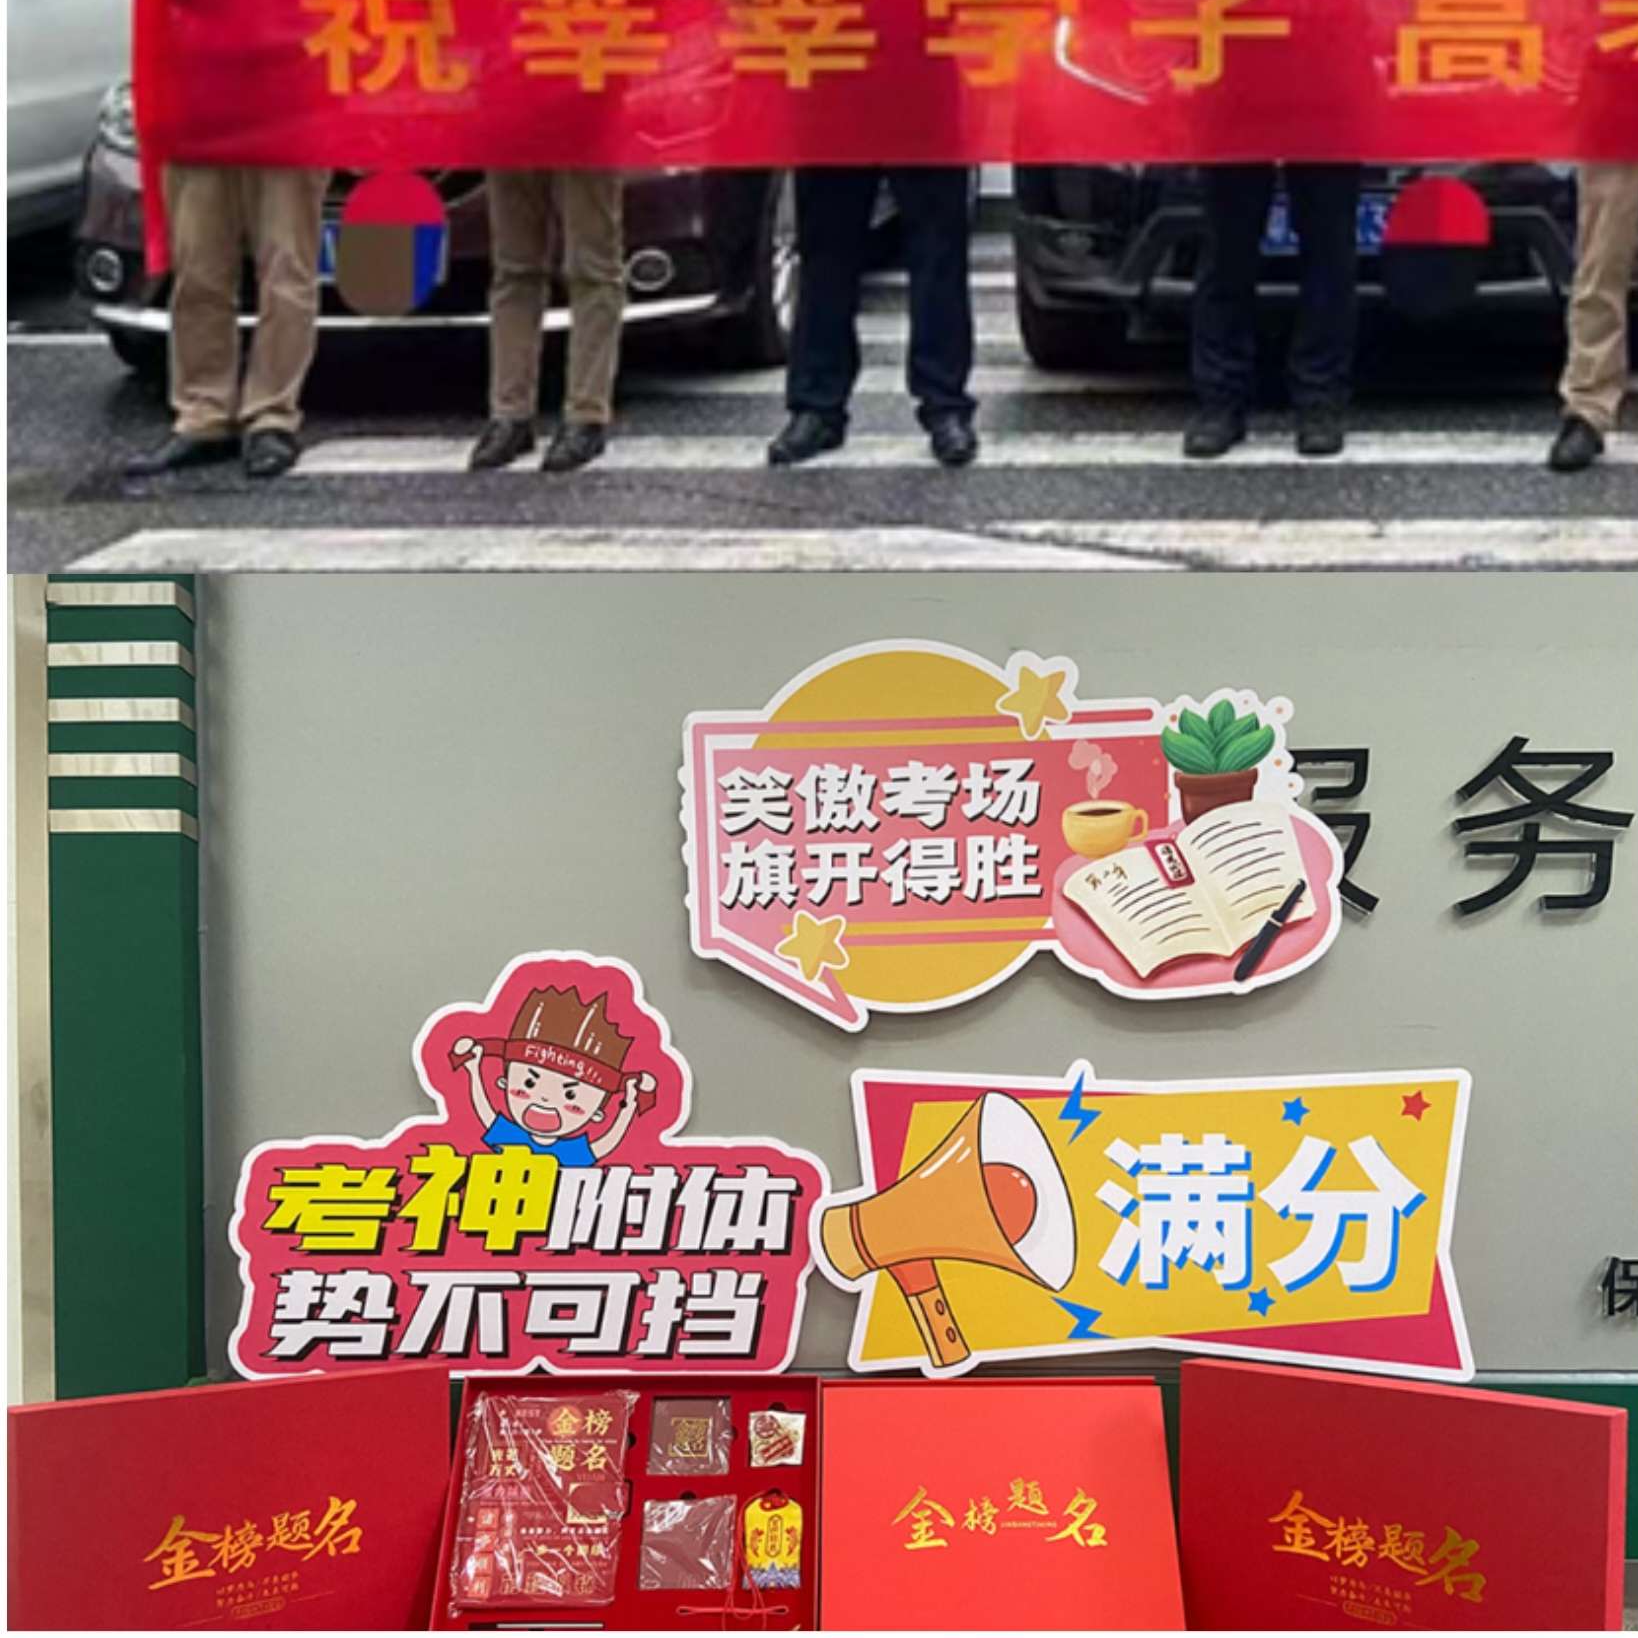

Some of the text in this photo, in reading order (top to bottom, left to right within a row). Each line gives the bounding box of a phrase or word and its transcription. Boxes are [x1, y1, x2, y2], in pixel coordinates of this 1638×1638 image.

[717, 756, 1043, 836] 笑傲考场
[719, 833, 1044, 909] 旗开得胜
[262, 1143, 800, 1254] 考神附体
[1094, 1133, 1428, 1293] 满分
[259, 1268, 766, 1359] 势不可挡
[553, 1407, 614, 1436] 金榜
[143, 1495, 364, 1590] 金榜题名
[891, 1477, 1109, 1551] 金榜题名
[1267, 1489, 1487, 1603] 金榜题名
